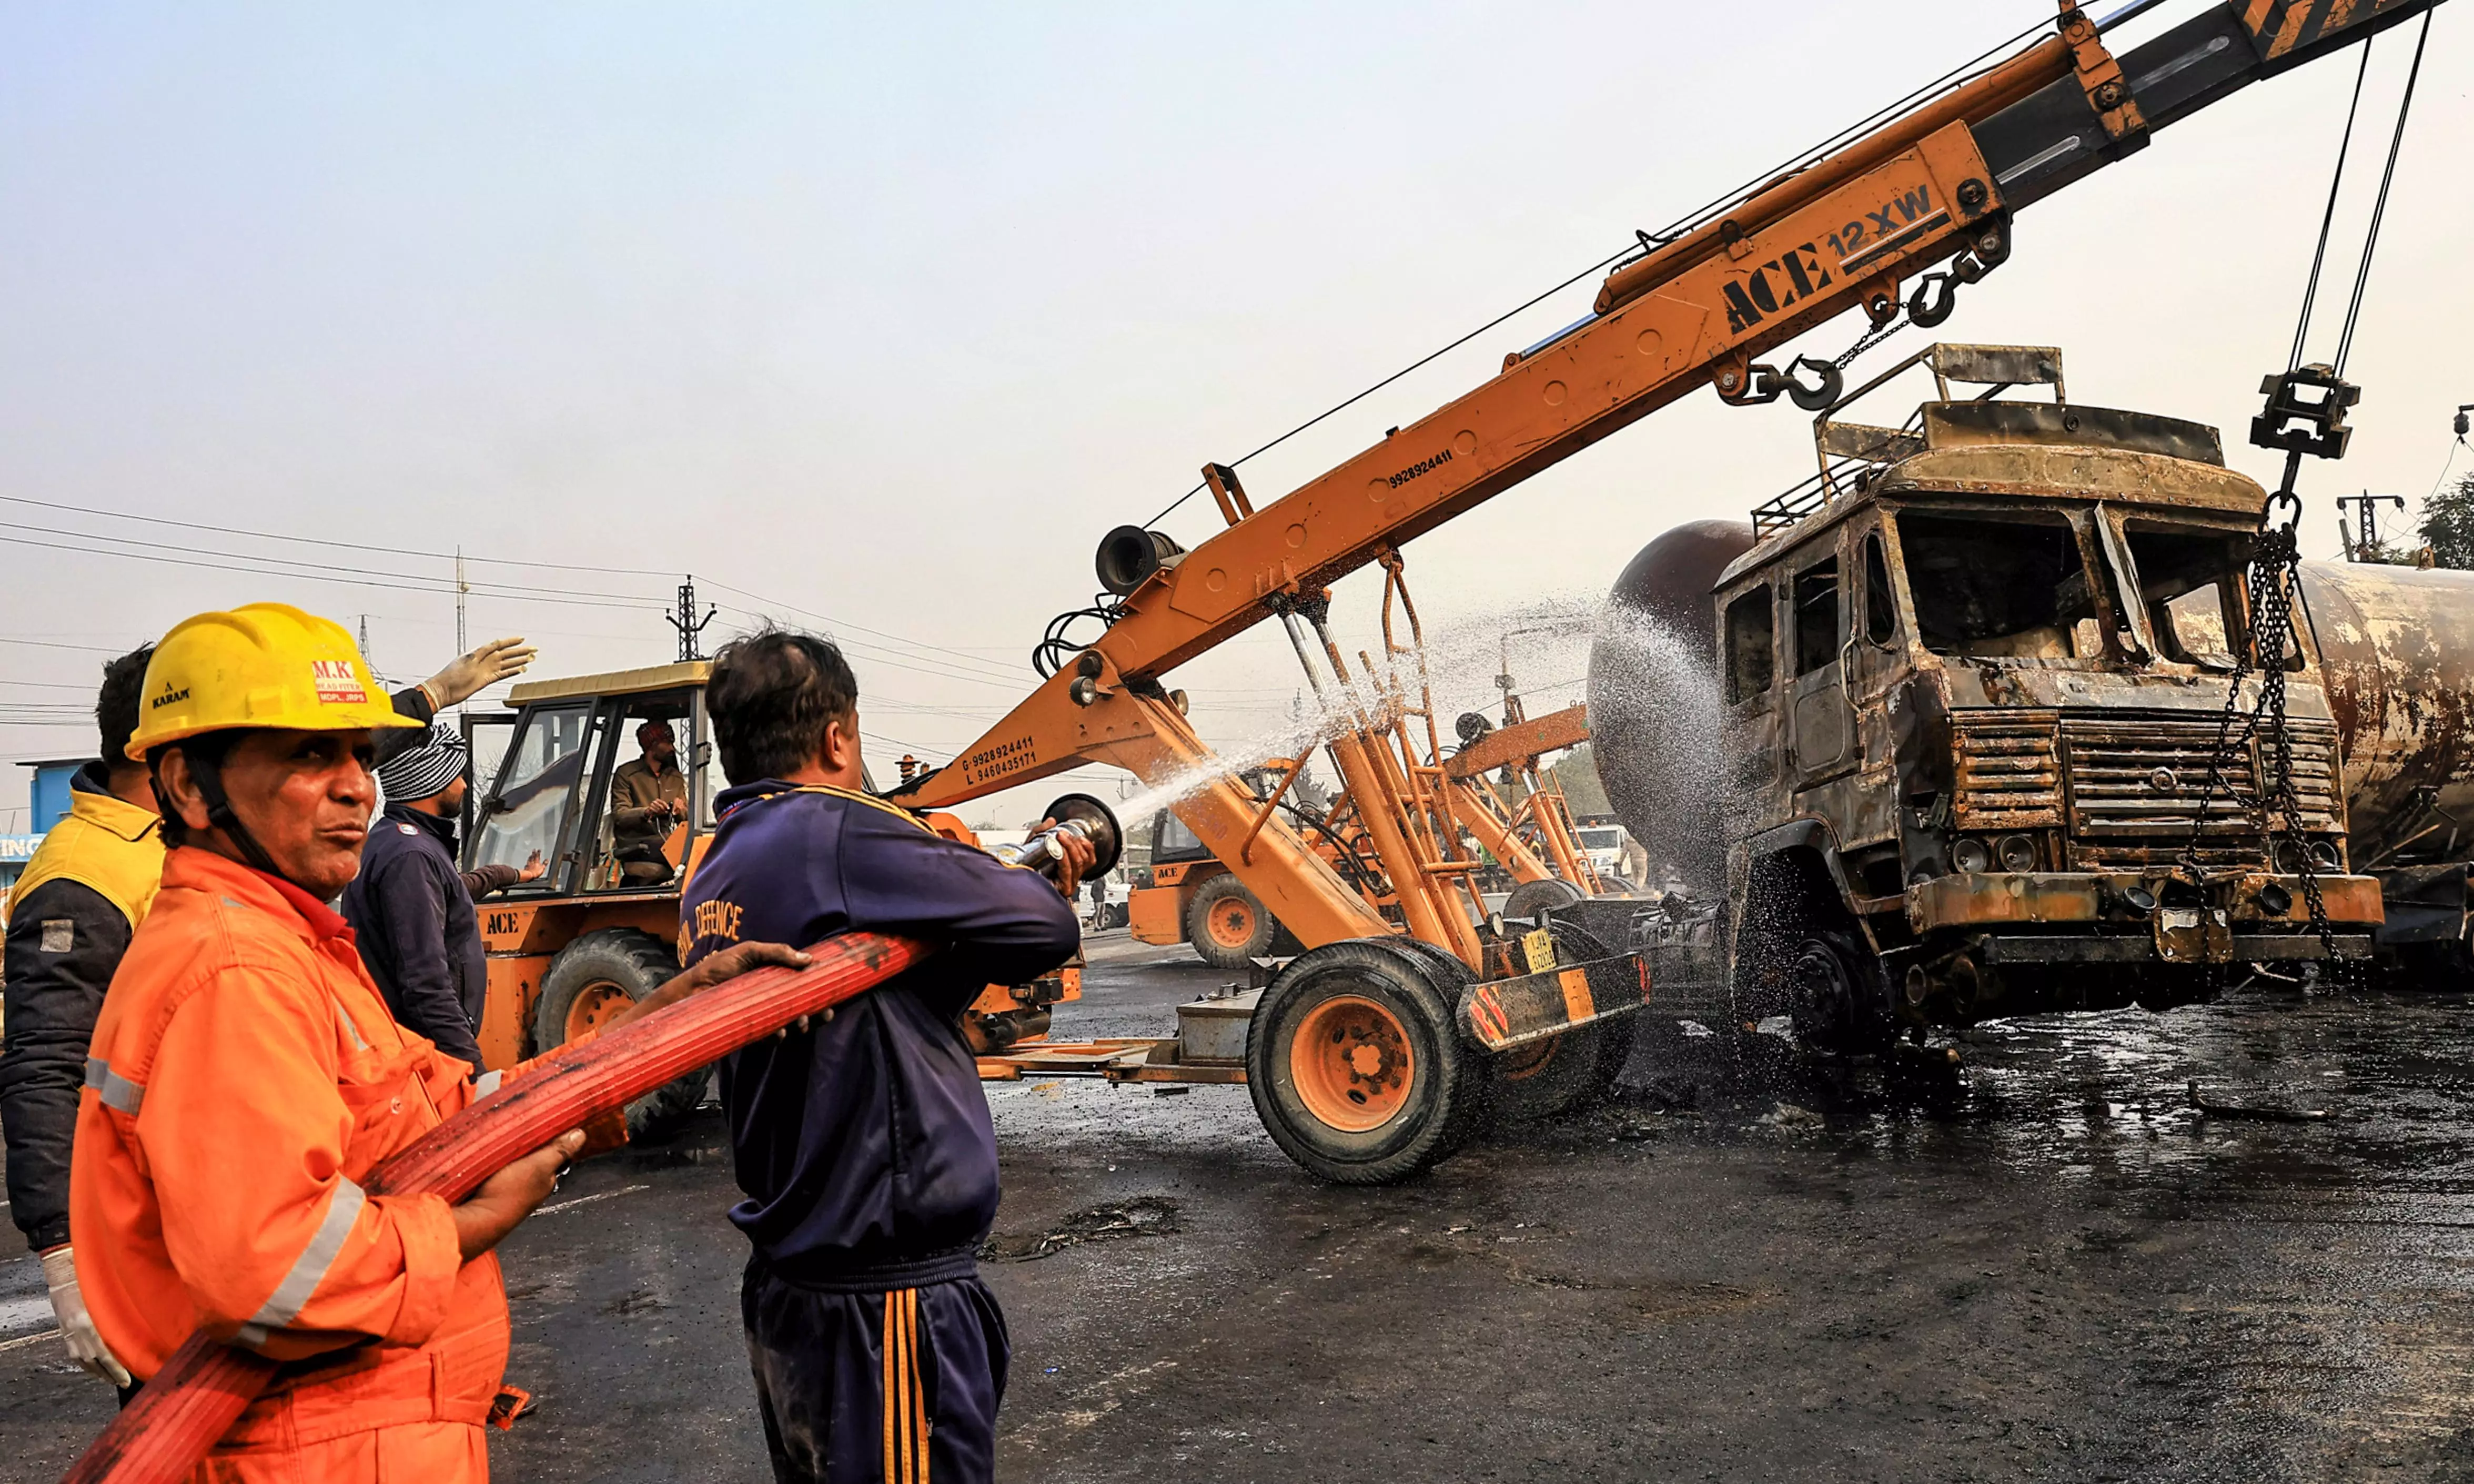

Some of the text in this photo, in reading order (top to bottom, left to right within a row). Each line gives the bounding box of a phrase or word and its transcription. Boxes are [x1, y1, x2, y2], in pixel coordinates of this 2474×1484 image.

[1723, 243, 1832, 335] ACE
[1389, 449, 1453, 489] 9928924411
[152, 687, 190, 710] KARAM
[977, 751, 1036, 782] 9460435171
[1158, 867, 1178, 878] ACE
[487, 912, 519, 935] ACE
[695, 899, 744, 942] DEFENCE
